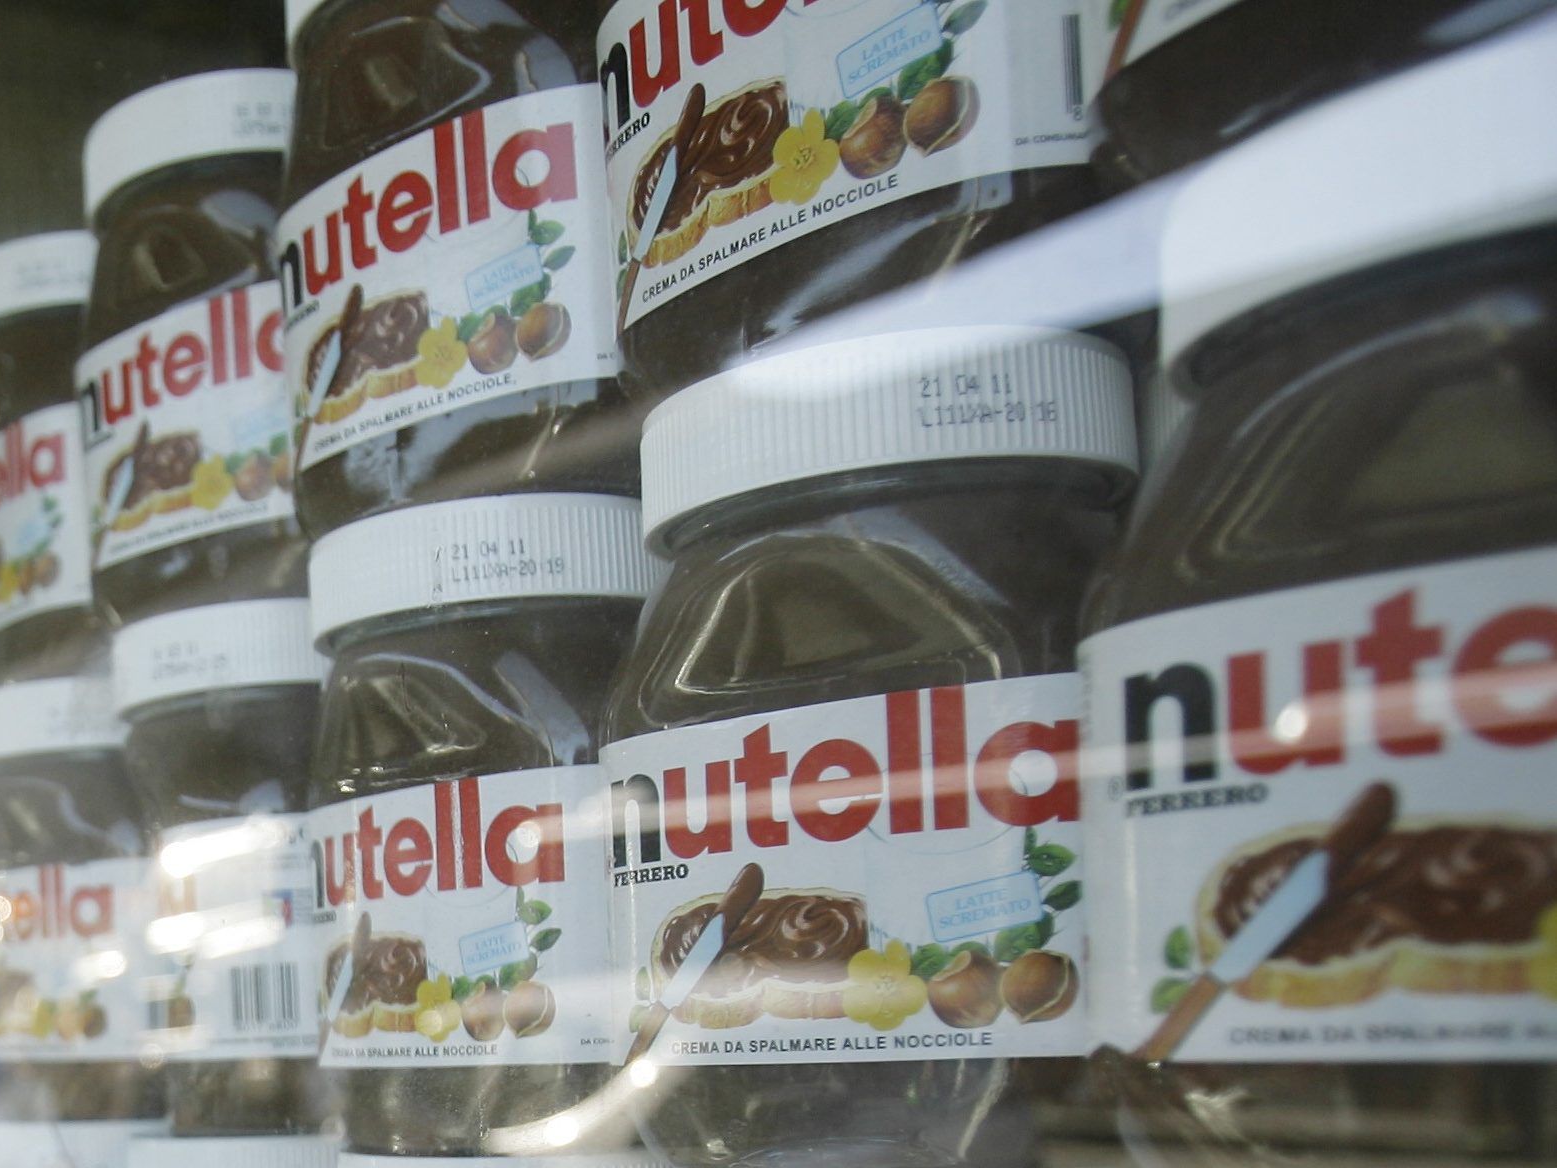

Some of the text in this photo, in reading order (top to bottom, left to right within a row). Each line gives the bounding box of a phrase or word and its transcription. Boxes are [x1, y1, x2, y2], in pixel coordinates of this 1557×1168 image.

[642, 173, 899, 304] CREMA DA SPALMARE ALLE NOCCIOLE
[447, 374, 513, 404] NOCCIOLE
[508, 539, 526, 555] 11
[610, 684, 1081, 868] nutella
[1127, 782, 1268, 819] FERRERO
[613, 862, 690, 889] FERRERO
[414, 1044, 440, 1057] ALLE
[442, 1043, 499, 1057] NOCCIOLE
[671, 1031, 994, 1056] CREMA DA SPALMARE ALLE NOCCIOLE
